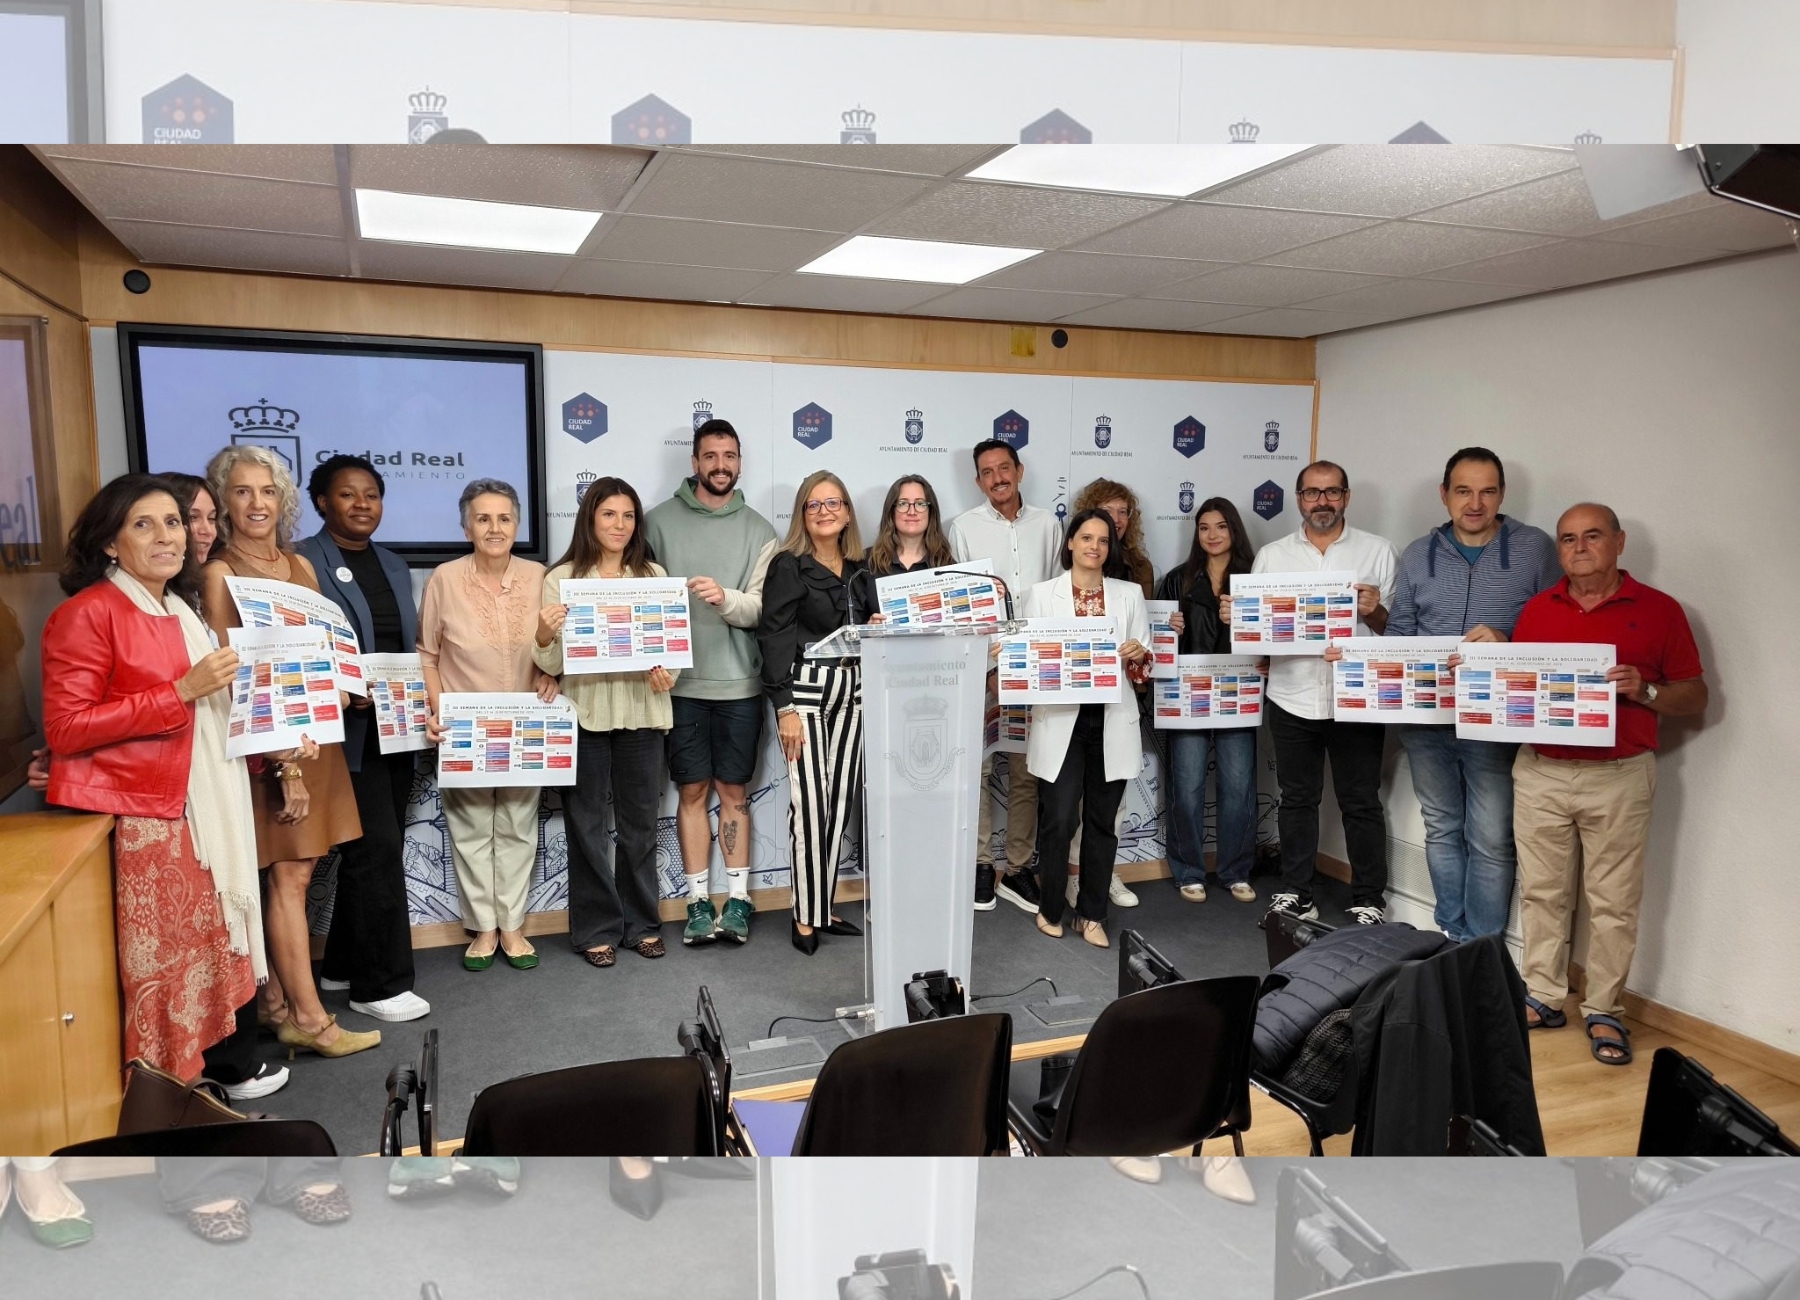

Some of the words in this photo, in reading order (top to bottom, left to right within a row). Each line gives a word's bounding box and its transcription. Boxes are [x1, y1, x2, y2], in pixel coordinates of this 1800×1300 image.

[154, 127, 202, 140] CIUDAD
[412, 452, 464, 466] Real
[382, 471, 465, 480] AMIENTO
[934, 674, 959, 686] Real
